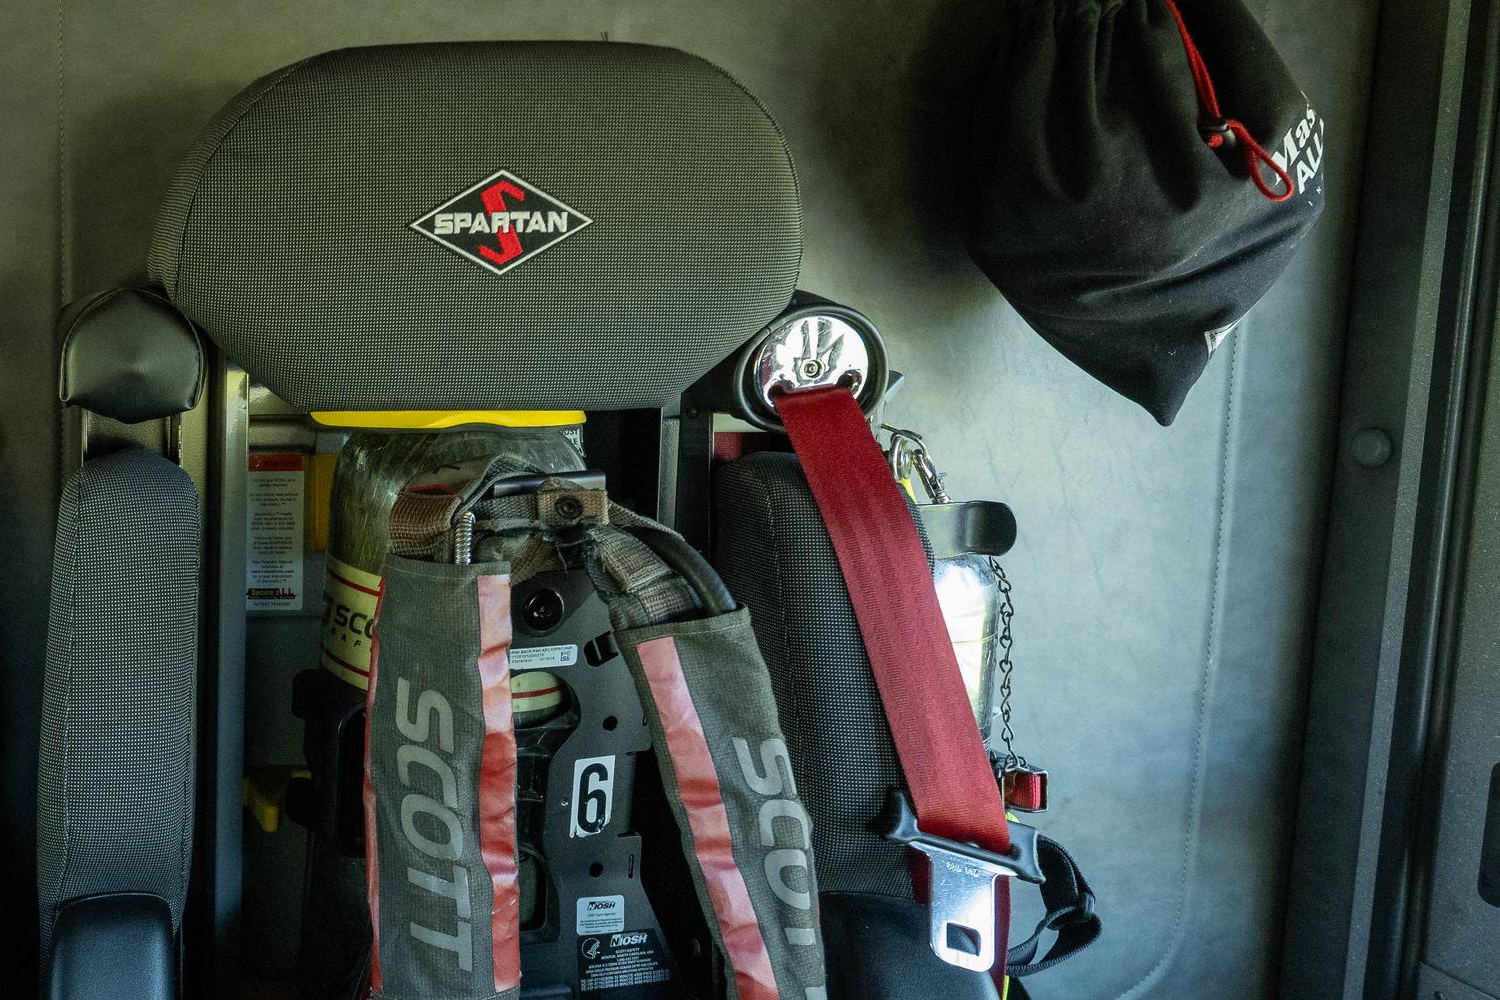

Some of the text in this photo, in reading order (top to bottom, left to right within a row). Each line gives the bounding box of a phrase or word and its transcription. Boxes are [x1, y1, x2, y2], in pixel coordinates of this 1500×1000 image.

[434, 211, 568, 234] SPARTAN
[577, 763, 609, 833] 6
[395, 676, 473, 972] SCOTT
[588, 901, 616, 911] NIOSH
[610, 934, 648, 947] NIOSH
